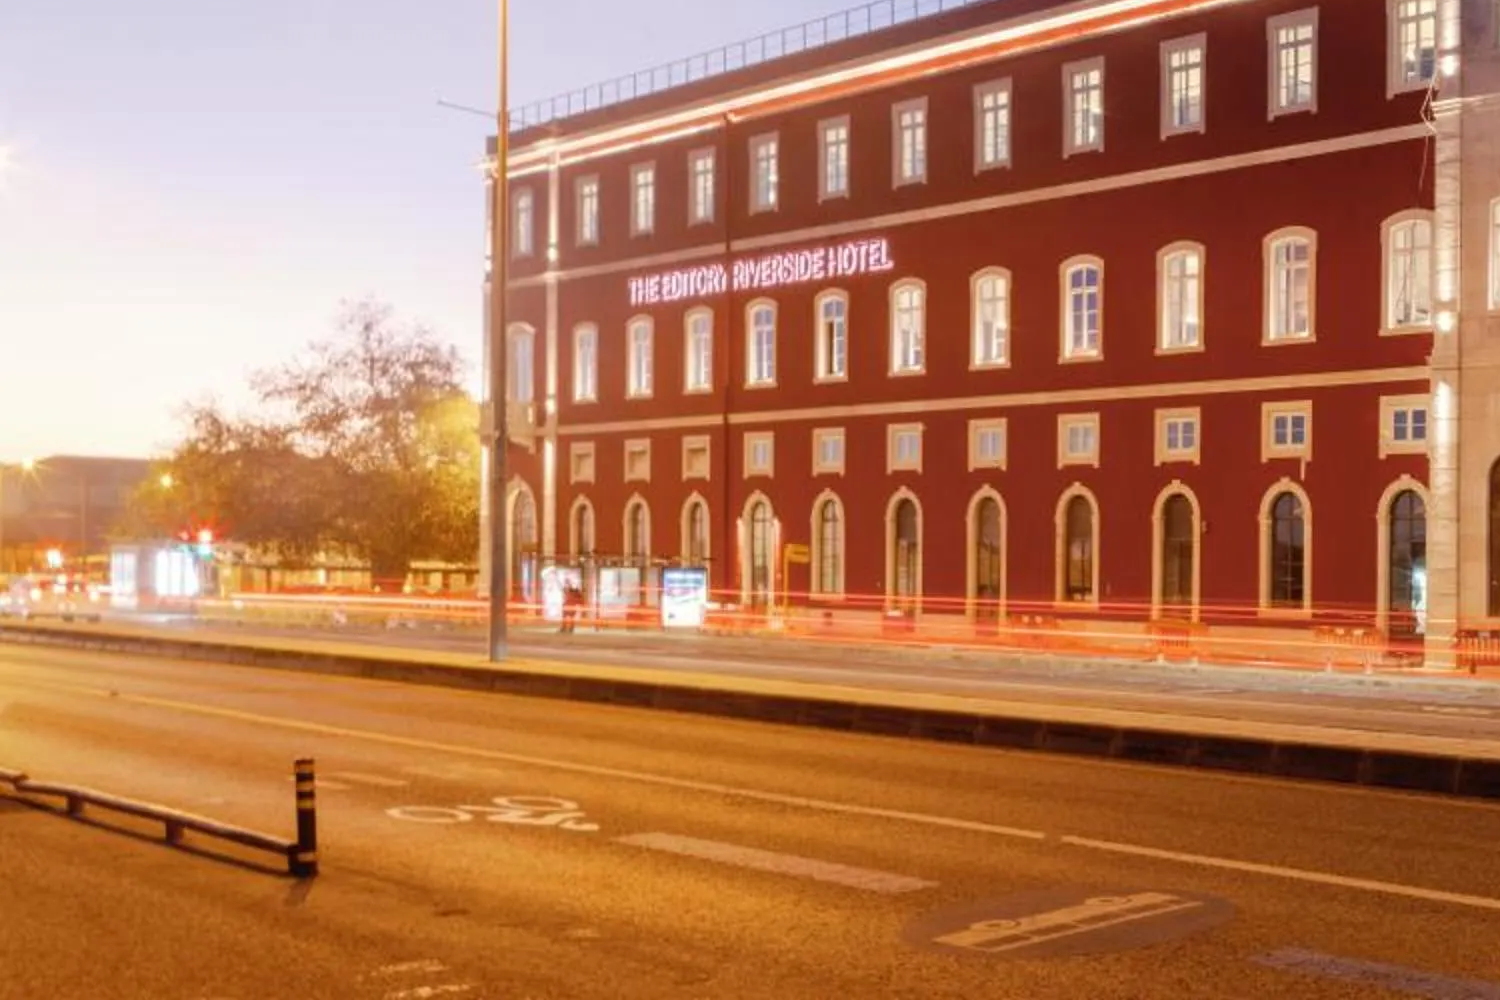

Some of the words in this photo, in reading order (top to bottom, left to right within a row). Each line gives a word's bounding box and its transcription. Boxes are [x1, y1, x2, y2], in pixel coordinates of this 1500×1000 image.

[629, 277, 660, 306] THE
[733, 247, 825, 291] RIVERSIDE
[828, 239, 894, 277] HOTEL
